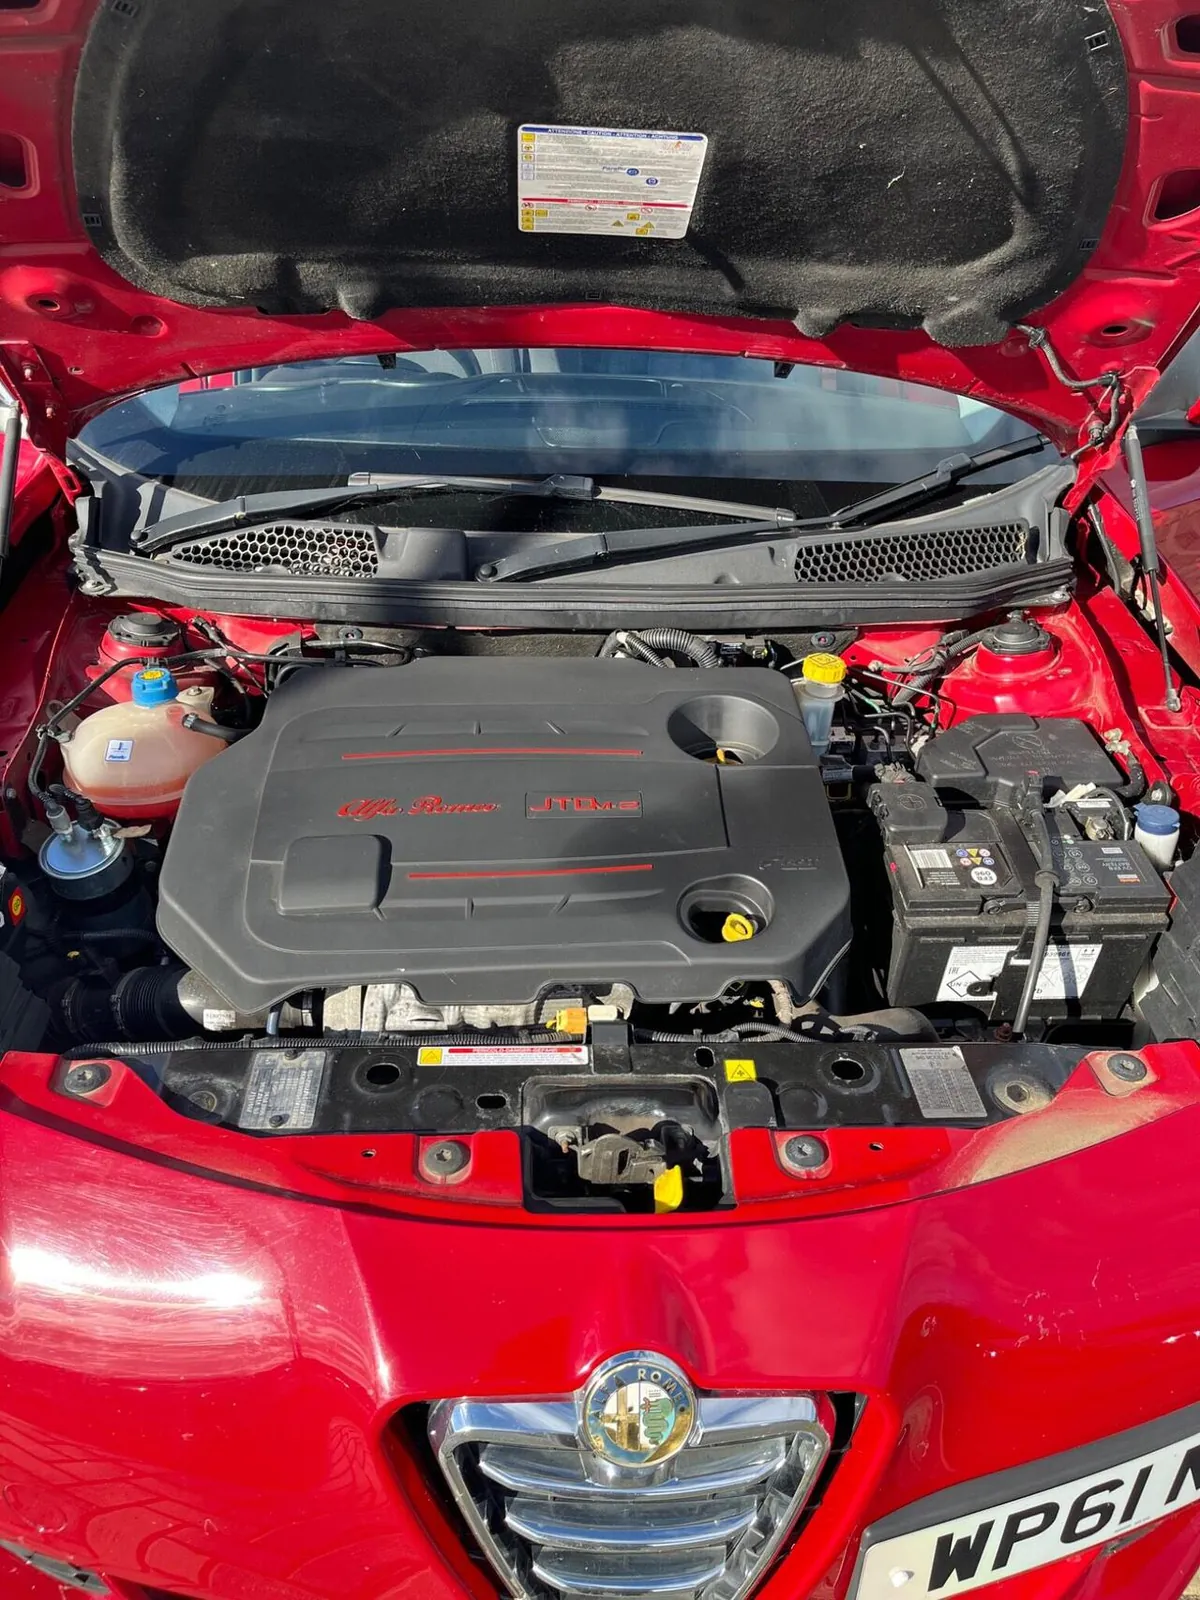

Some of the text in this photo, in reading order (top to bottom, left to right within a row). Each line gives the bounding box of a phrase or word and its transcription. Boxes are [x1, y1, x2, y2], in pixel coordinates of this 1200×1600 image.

[337, 794, 500, 821] Alfa Romeo
[928, 1464, 1153, 1592] WP61
